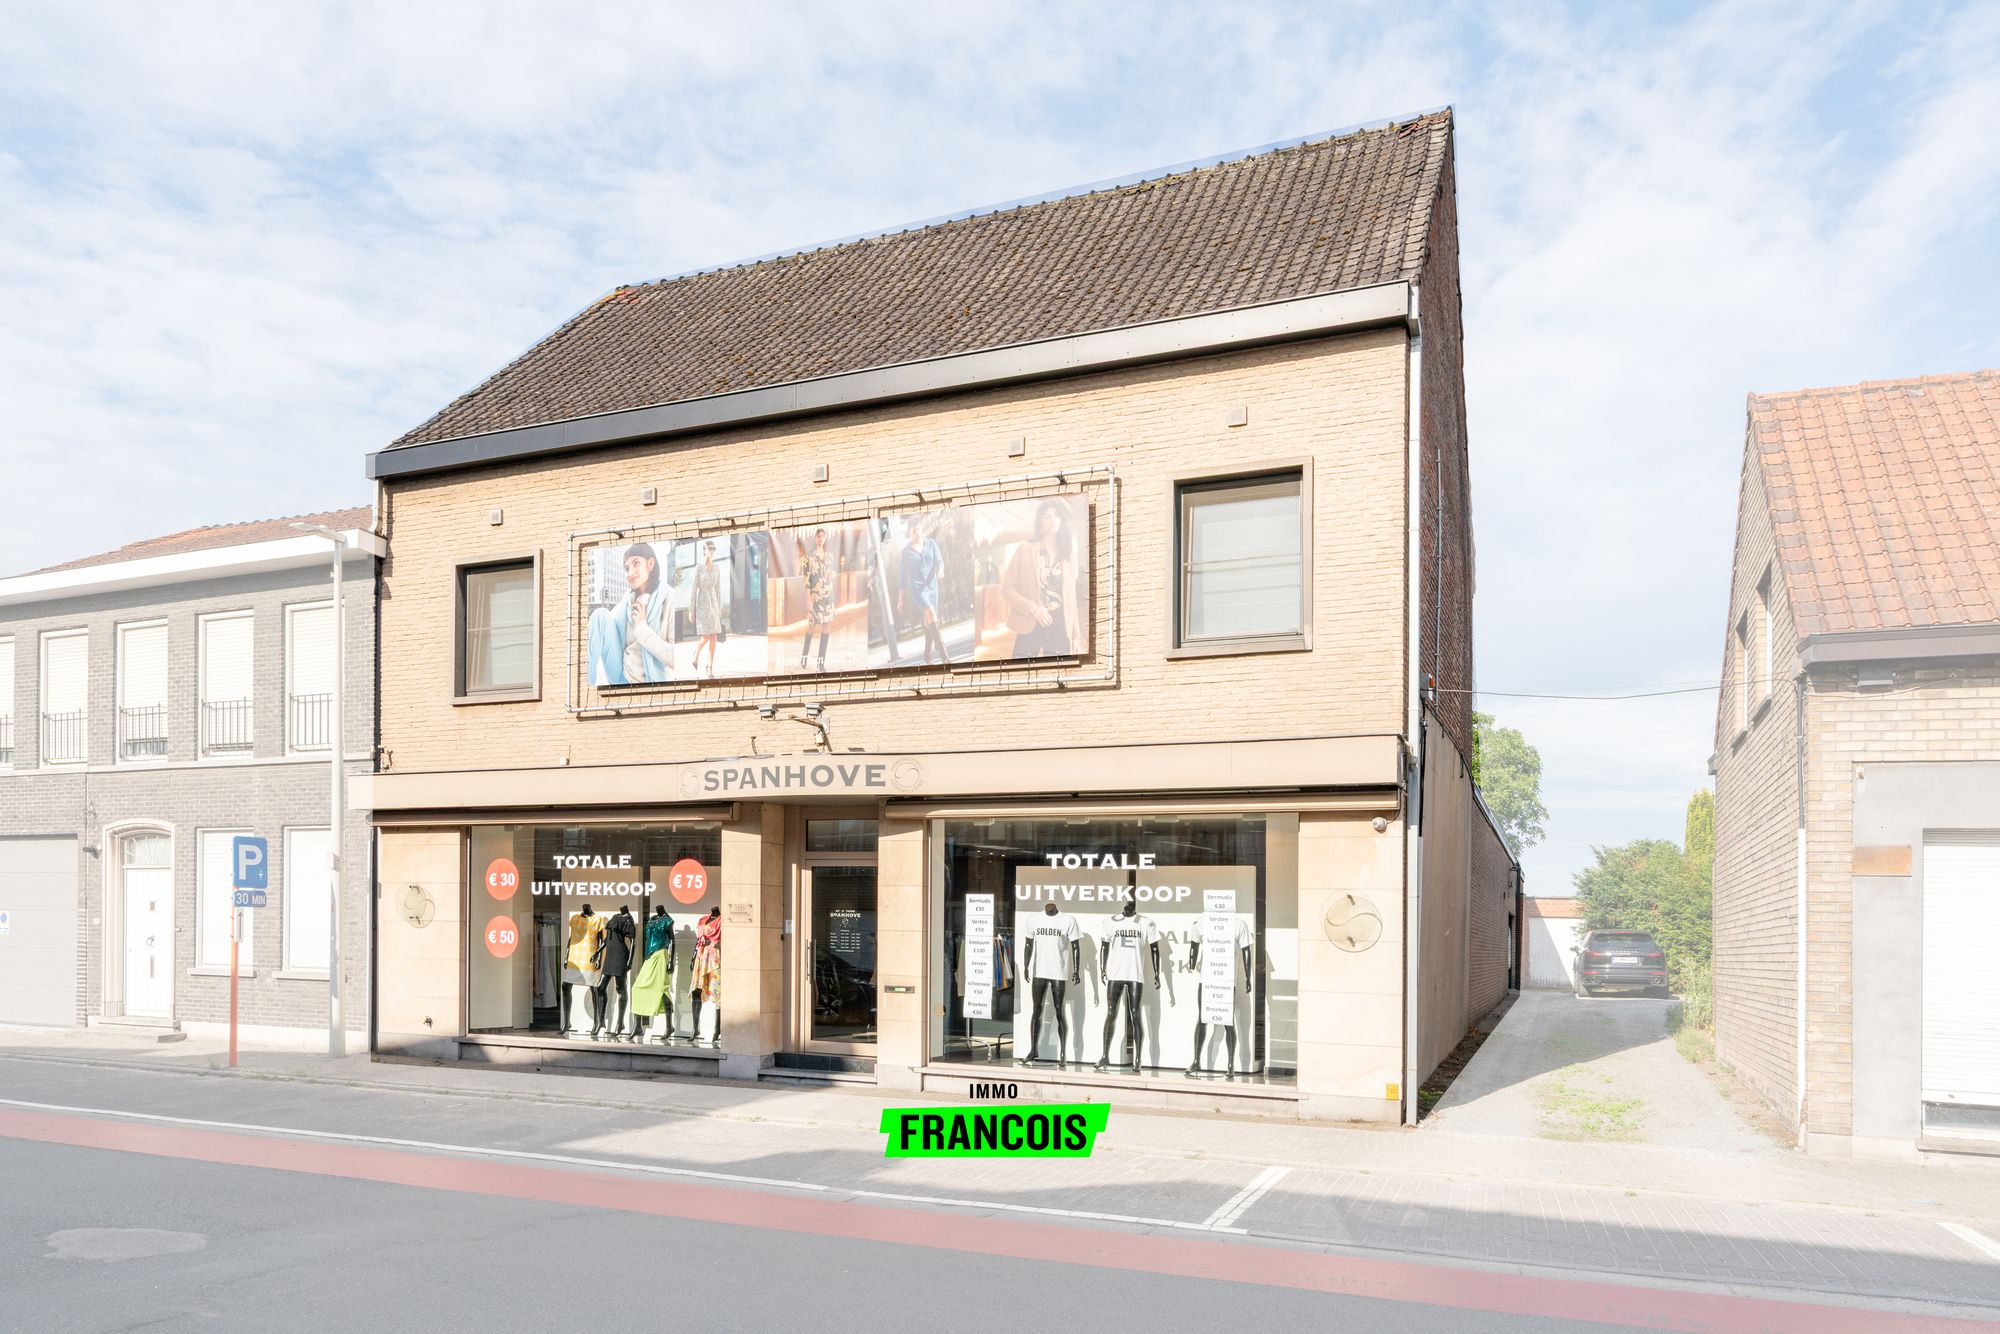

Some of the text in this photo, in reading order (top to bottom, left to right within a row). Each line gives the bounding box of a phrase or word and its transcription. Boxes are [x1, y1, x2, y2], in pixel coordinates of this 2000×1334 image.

[704, 764, 886, 791] SPANHOVE
[238, 844, 263, 880] P
[553, 855, 632, 870] TOTALE
[1046, 853, 1156, 870] TOTALE
[500, 873, 516, 886] 30
[686, 874, 704, 889] 75
[531, 881, 657, 896] UITVERKOOP
[1015, 885, 1192, 902] UITVERKOOP
[236, 892, 266, 905] 30 MIN
[499, 930, 515, 944] 50
[1036, 927, 1062, 938] SOLDEN
[1115, 928, 1142, 939] SOLDEN
